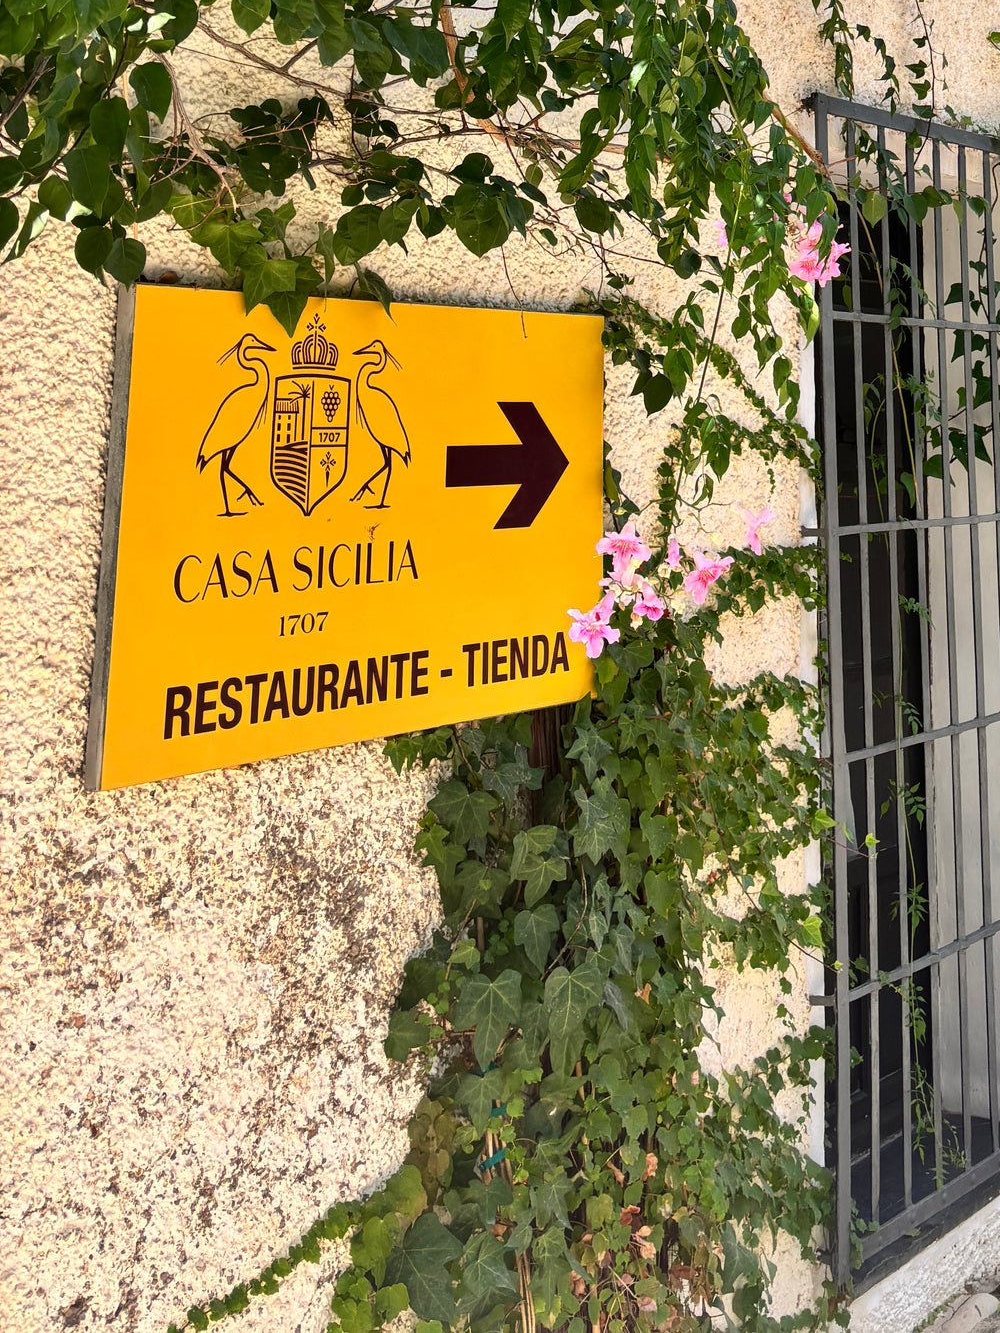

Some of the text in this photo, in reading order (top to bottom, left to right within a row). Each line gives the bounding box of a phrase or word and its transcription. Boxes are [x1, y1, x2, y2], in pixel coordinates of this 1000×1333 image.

[319, 432, 341, 443] 1707
[173, 538, 419, 603] CASA SICILIA
[279, 611, 329, 637] 1707
[163, 649, 430, 740] RESTAURANTE
[462, 631, 570, 688] TIENDA
